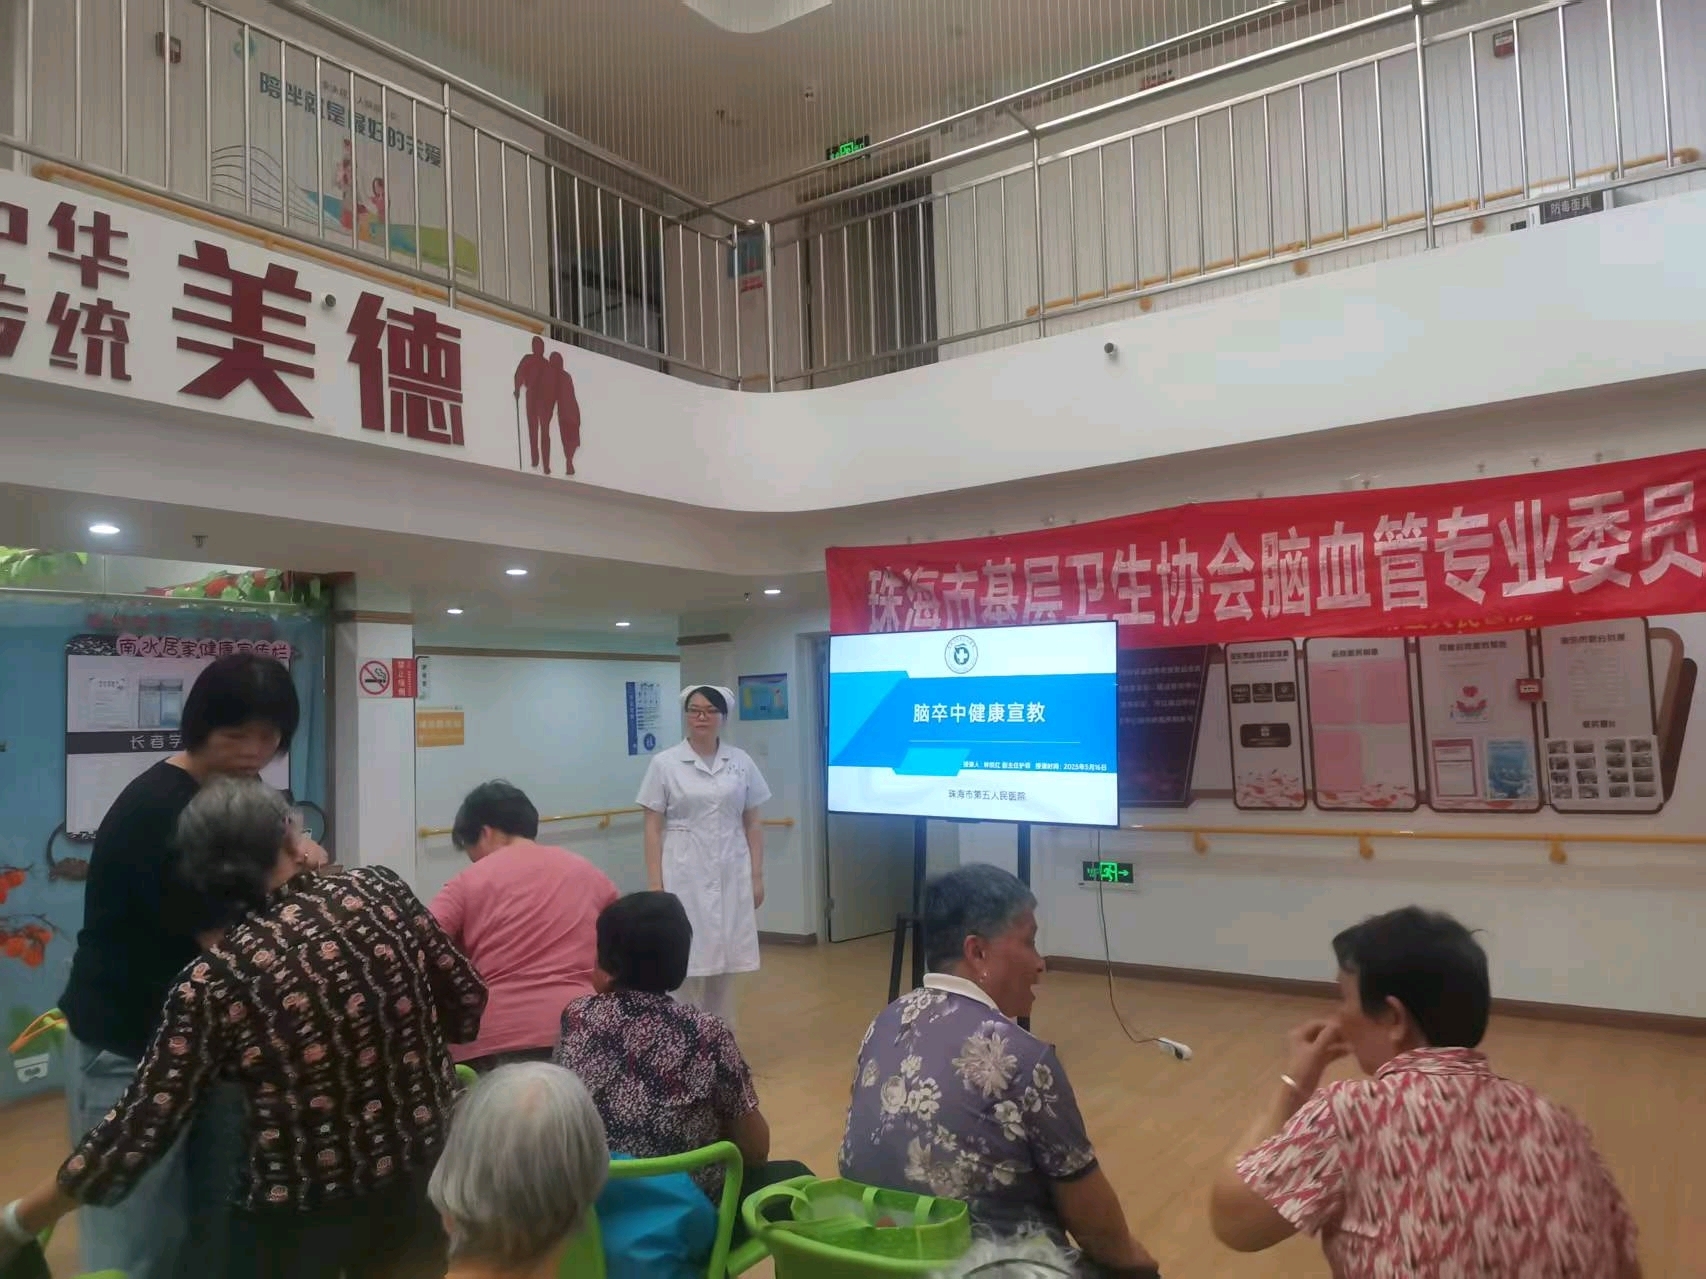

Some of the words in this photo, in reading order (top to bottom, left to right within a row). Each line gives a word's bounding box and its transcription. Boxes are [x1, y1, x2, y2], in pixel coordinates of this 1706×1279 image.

[1549, 195, 1592, 217] 防毒面具
[172, 239, 465, 447] 美德
[867, 480, 1706, 633] 珠海市基层卫生协会脑血管专业委员
[912, 701, 1047, 724] 脑卒中健康宣教
[947, 789, 1027, 802] 珠海市第五人民医院
